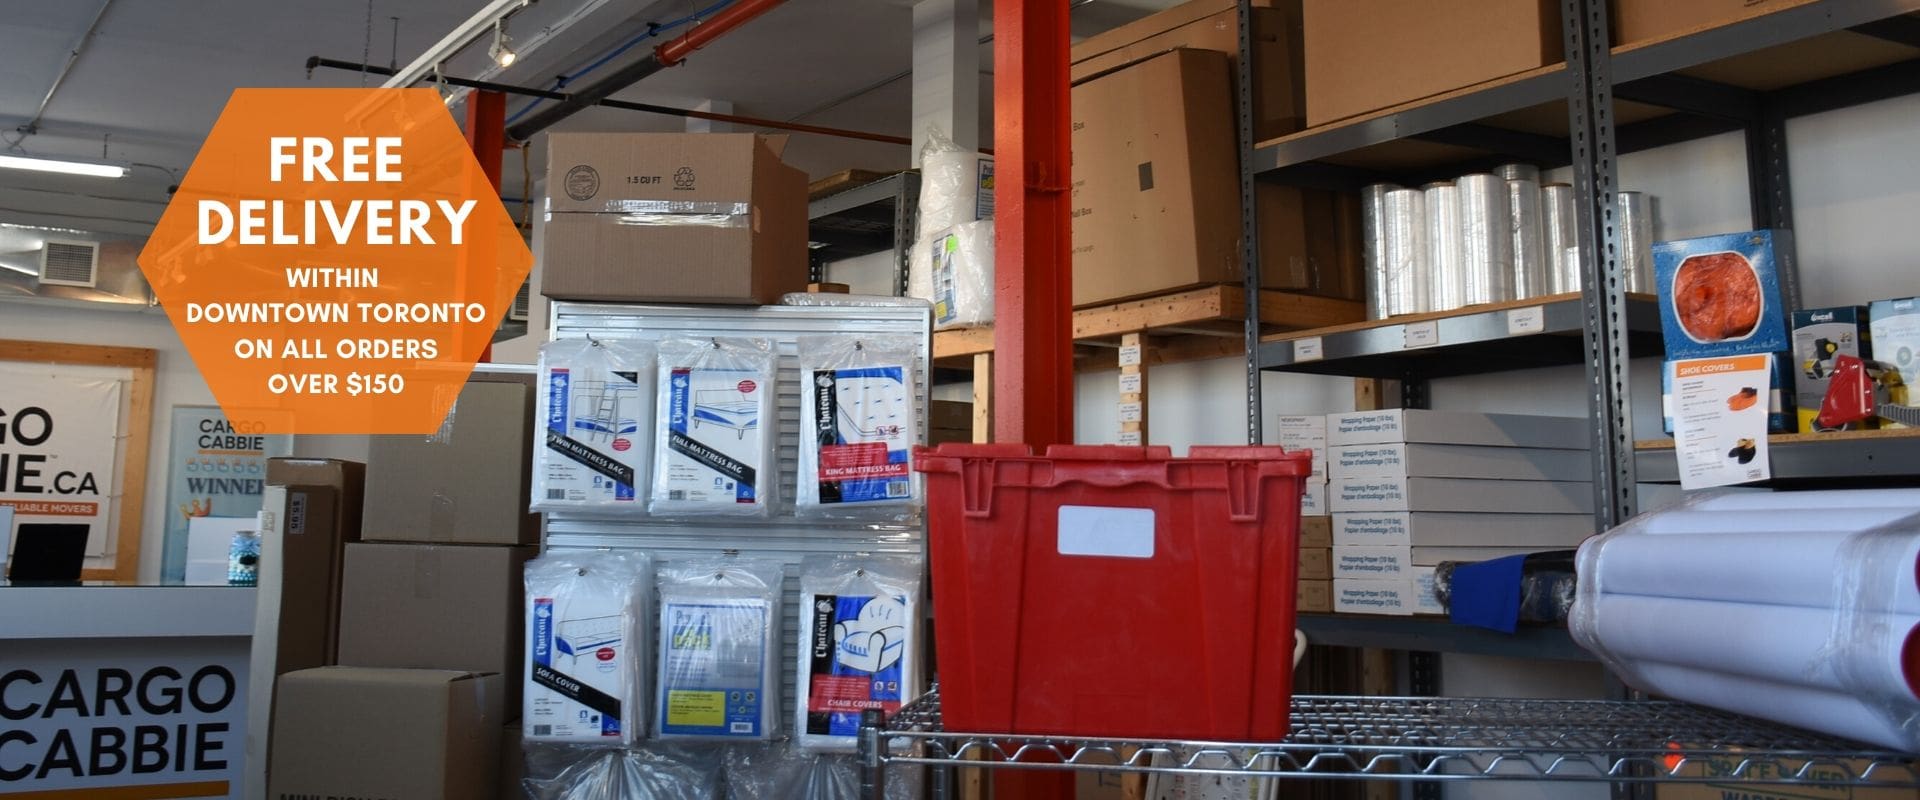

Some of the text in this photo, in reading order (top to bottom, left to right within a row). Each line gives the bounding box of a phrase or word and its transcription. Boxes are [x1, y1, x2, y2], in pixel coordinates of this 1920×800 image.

[626, 176, 662, 184] 1.5 CU FT
[1680, 363, 1735, 376] SHOE COVERS
[818, 387, 831, 431] Chateau
[199, 418, 266, 434] CARGO
[198, 435, 264, 451] CABBIE
[552, 435, 571, 450] TWIN
[571, 443, 608, 468] MATTRESS
[607, 461, 625, 476] BAG
[671, 434, 743, 475] FULL MATTRESS BAG
[825, 464, 901, 476] KING MATTRESS BAG
[50, 503, 93, 514] MOVERS
[815, 613, 829, 658] Chateau
[535, 666, 581, 693] SOFA COVER
[0, 664, 236, 720] CARGO
[827, 698, 883, 708] CHAIR COVERS
[0, 722, 230, 782] CABBIE
